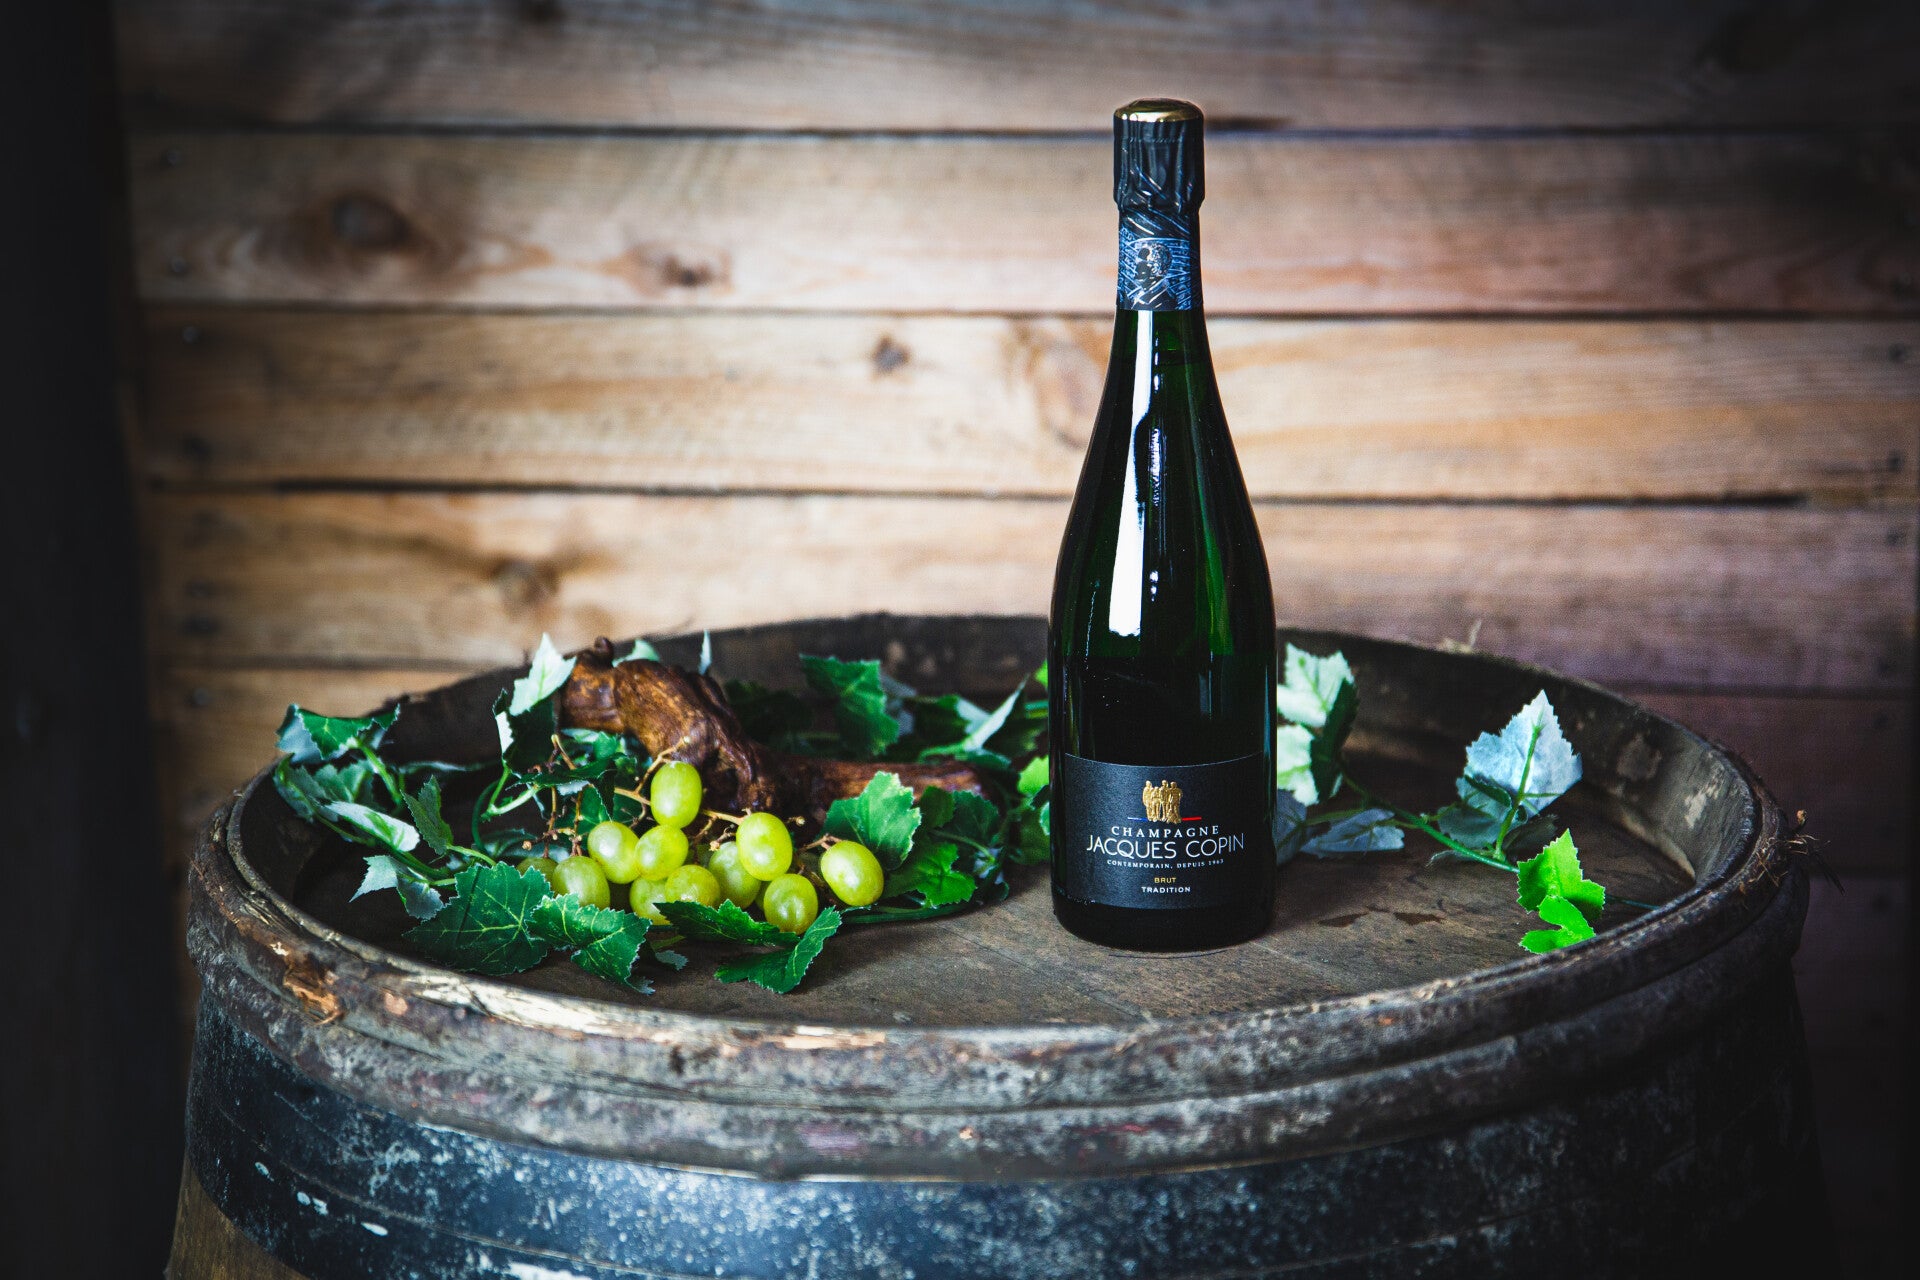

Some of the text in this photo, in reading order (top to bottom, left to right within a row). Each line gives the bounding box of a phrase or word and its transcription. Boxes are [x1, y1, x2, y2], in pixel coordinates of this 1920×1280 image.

[1111, 825, 1219, 838] CHAMPAGNE
[1086, 833, 1244, 859] JACQUES COPIN
[1176, 861, 1205, 869] DEPUIS
[1141, 886, 1191, 894] TRADITION
